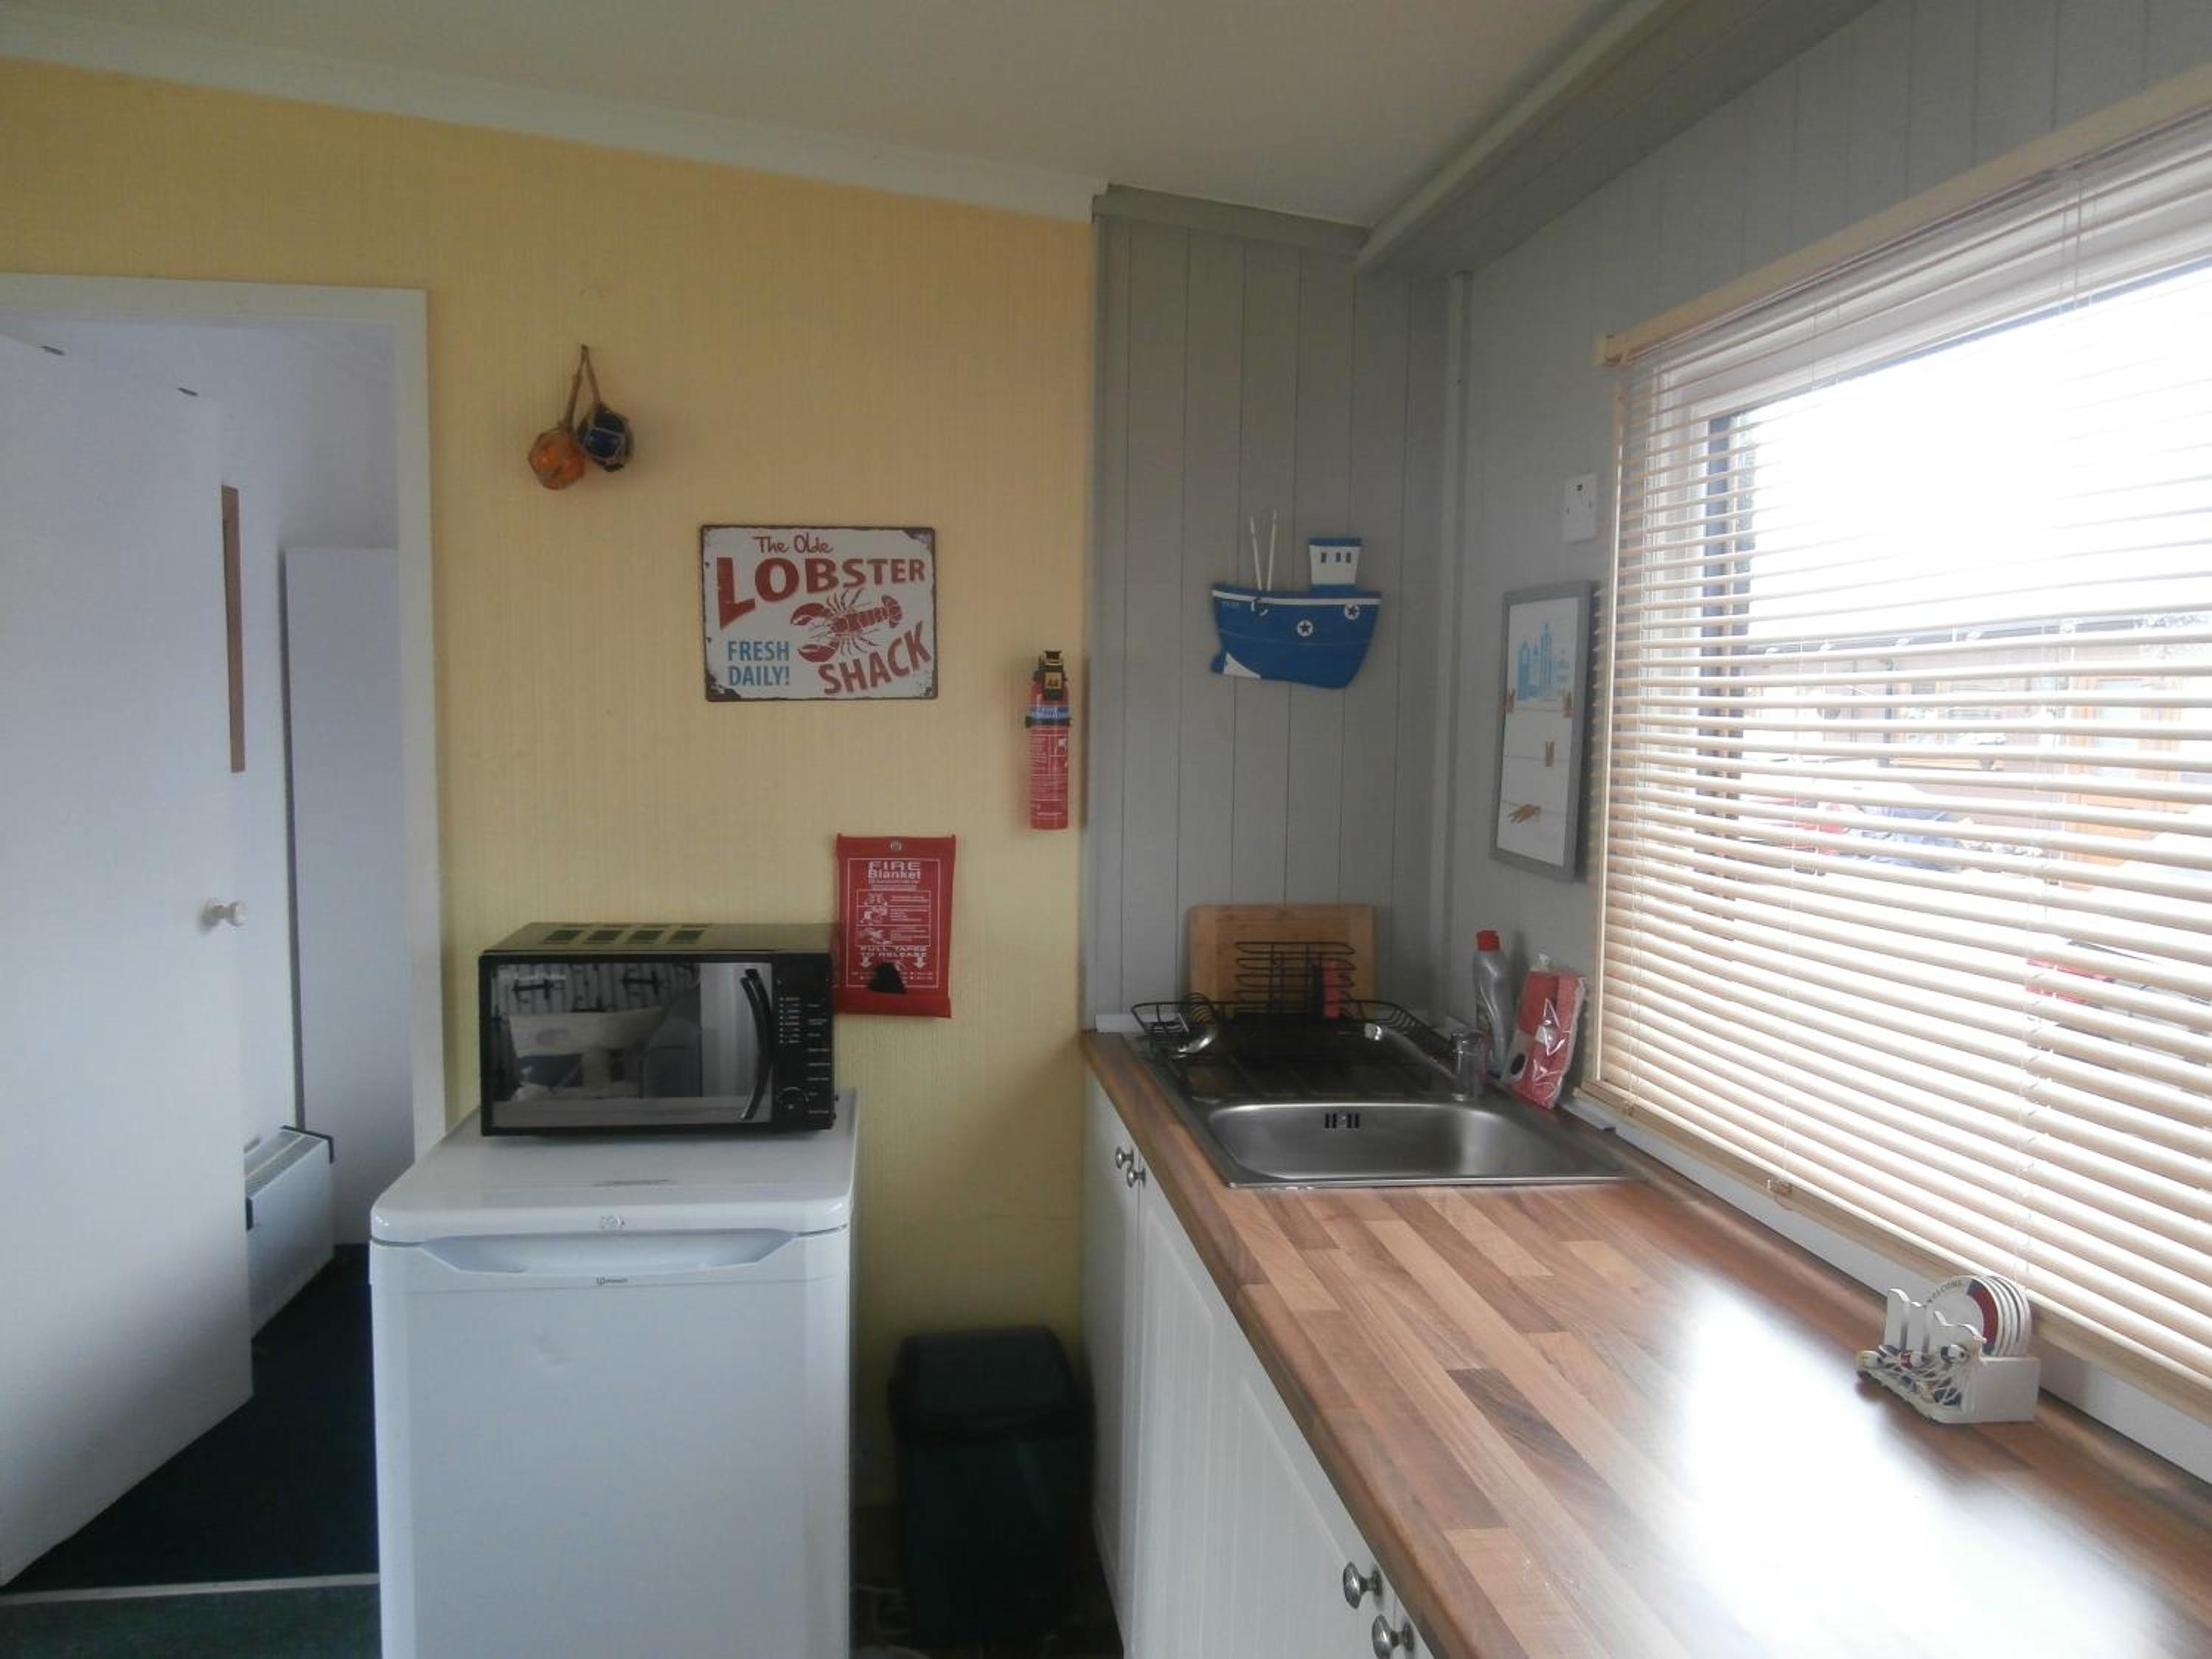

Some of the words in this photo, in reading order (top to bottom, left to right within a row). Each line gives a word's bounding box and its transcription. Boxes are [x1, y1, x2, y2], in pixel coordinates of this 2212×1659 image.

[752, 535, 789, 554] The
[793, 532, 834, 554] Olde
[716, 556, 926, 630] LOBSTER
[727, 640, 790, 661] FRESH
[817, 620, 931, 695] SHACK
[728, 665, 790, 686] DAILY!
[868, 860, 921, 871] FIRE
[868, 869, 921, 880] Blanket
